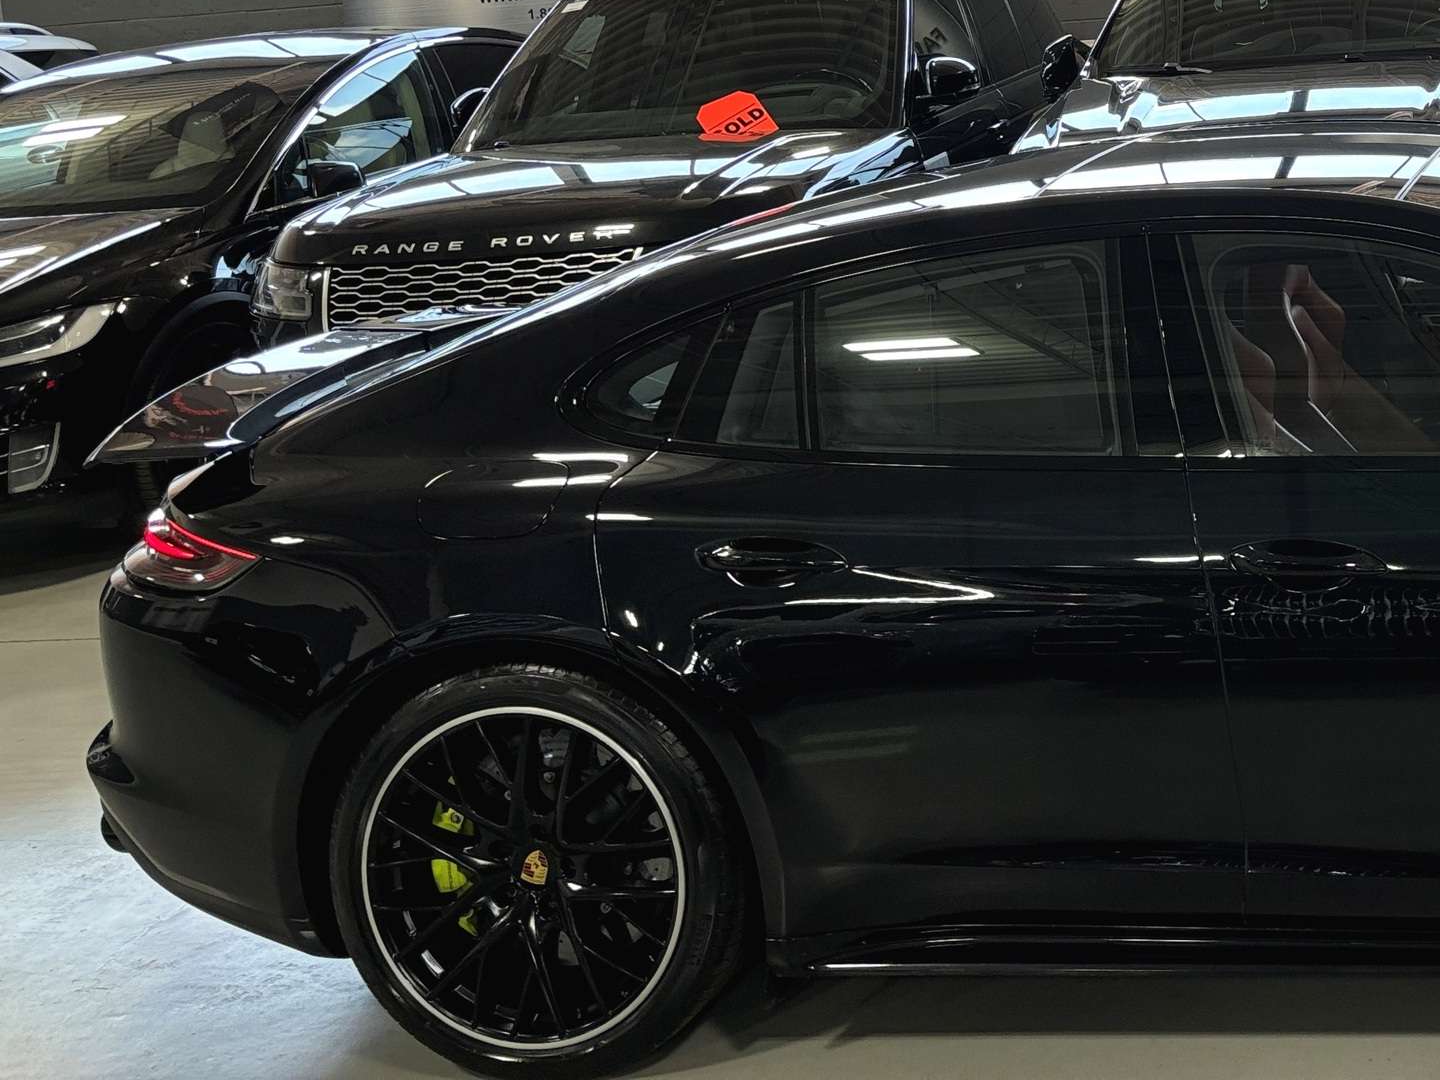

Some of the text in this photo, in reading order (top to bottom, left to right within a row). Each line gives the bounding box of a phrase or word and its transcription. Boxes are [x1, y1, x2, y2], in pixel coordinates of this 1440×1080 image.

[713, 108, 765, 134] OLD
[352, 230, 614, 255] RANGE ROVER
